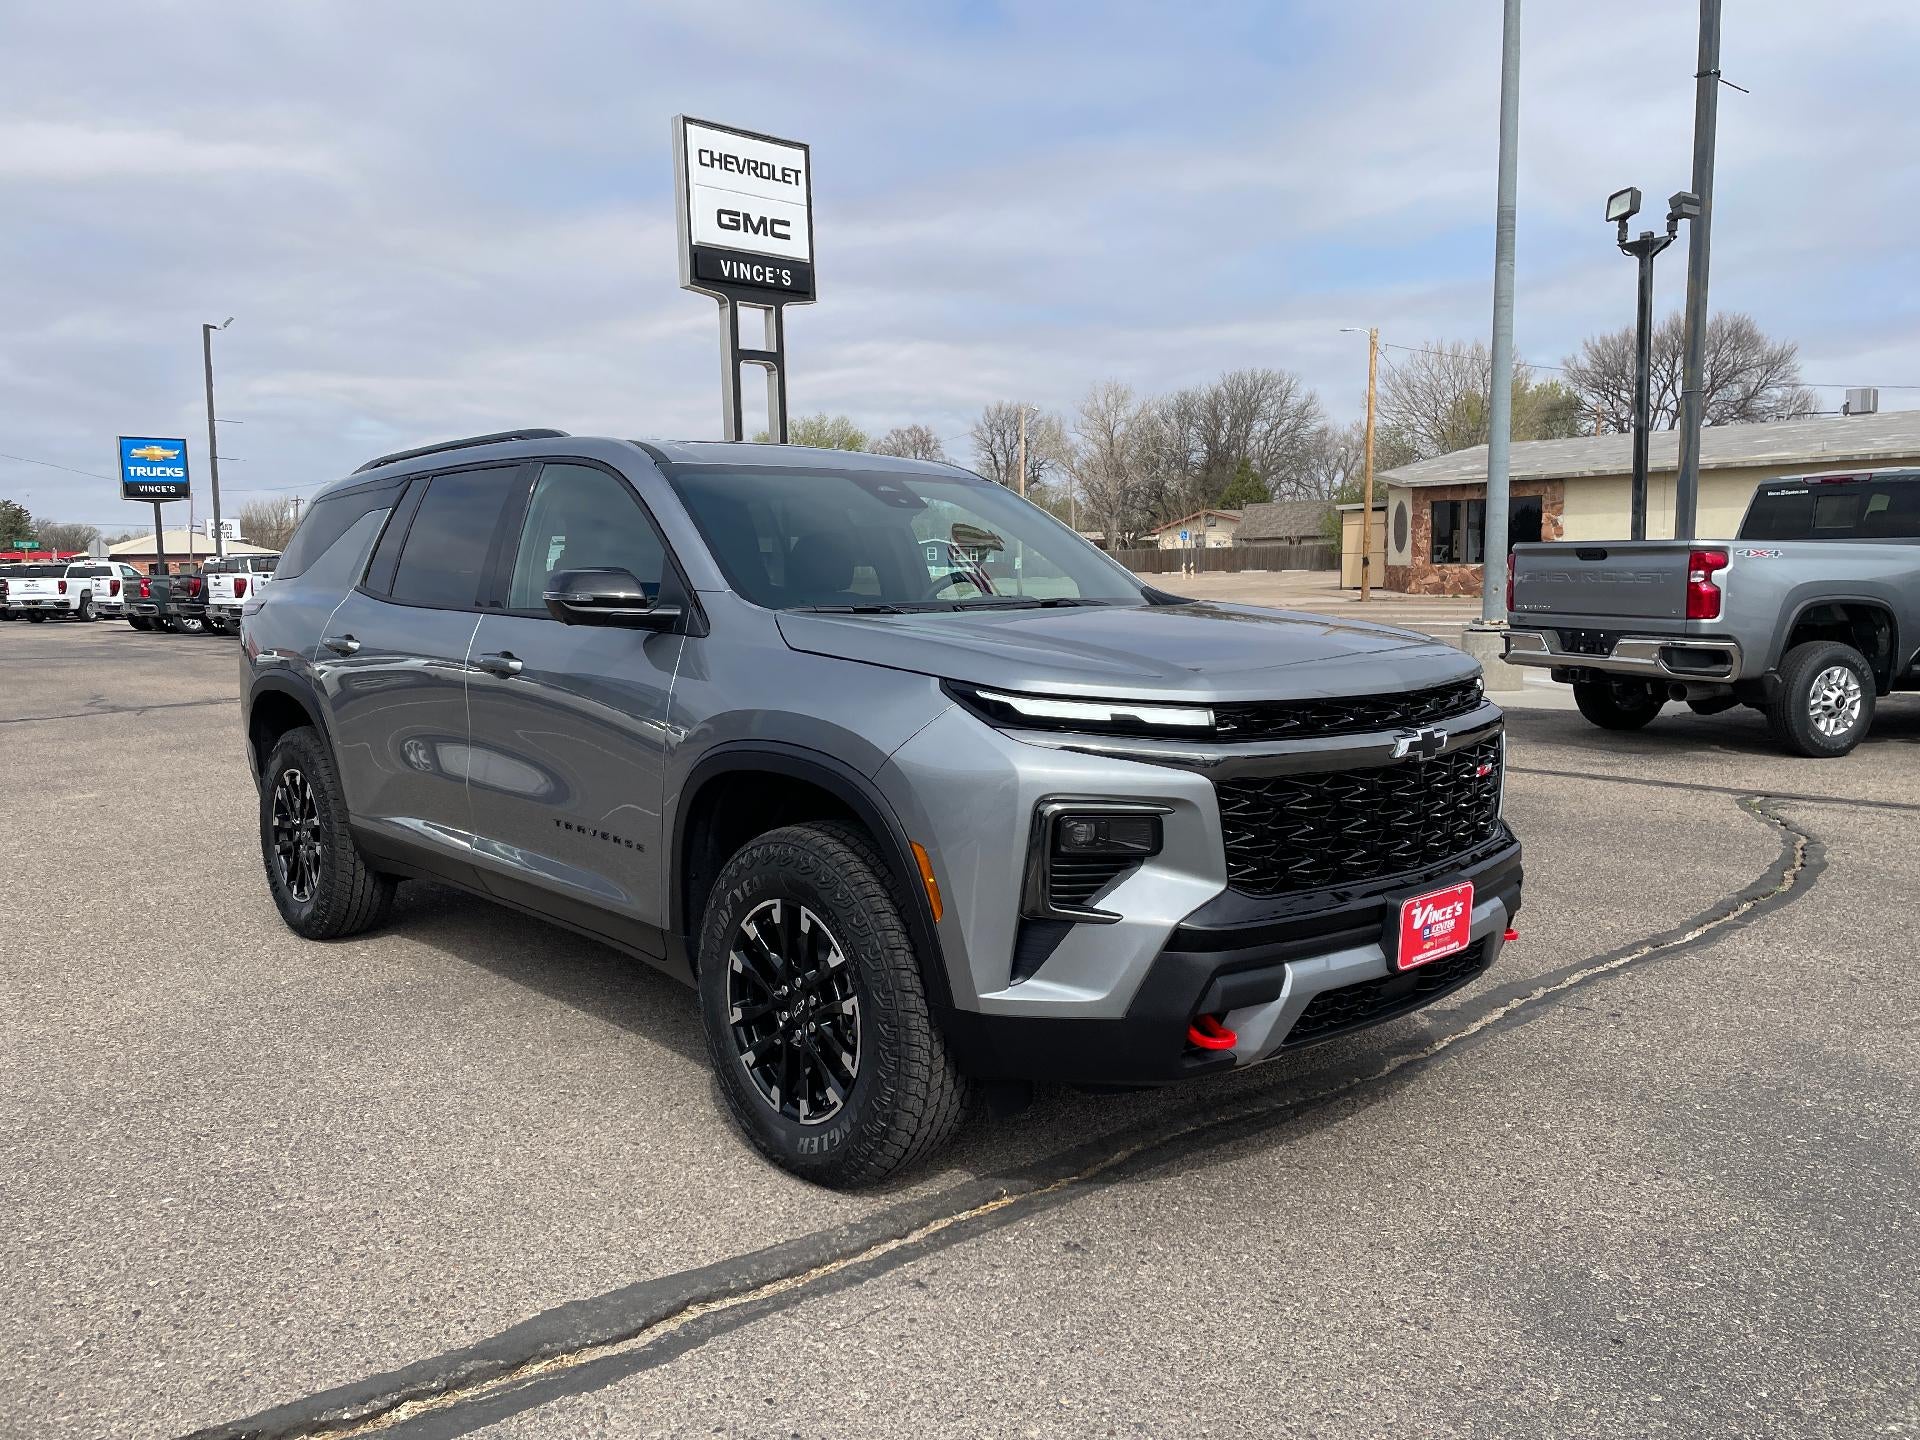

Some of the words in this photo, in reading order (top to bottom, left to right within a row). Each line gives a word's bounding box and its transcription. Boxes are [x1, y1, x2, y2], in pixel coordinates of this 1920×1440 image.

[698, 148, 801, 186] CHEVROLET
[716, 208, 791, 240] GMC
[720, 259, 792, 286] VINCE'S
[128, 466, 184, 477] TRUCKS
[138, 485, 176, 493] VINCE'S
[1522, 570, 1673, 585] CHEVROLET
[552, 818, 646, 853] TRAVERSE
